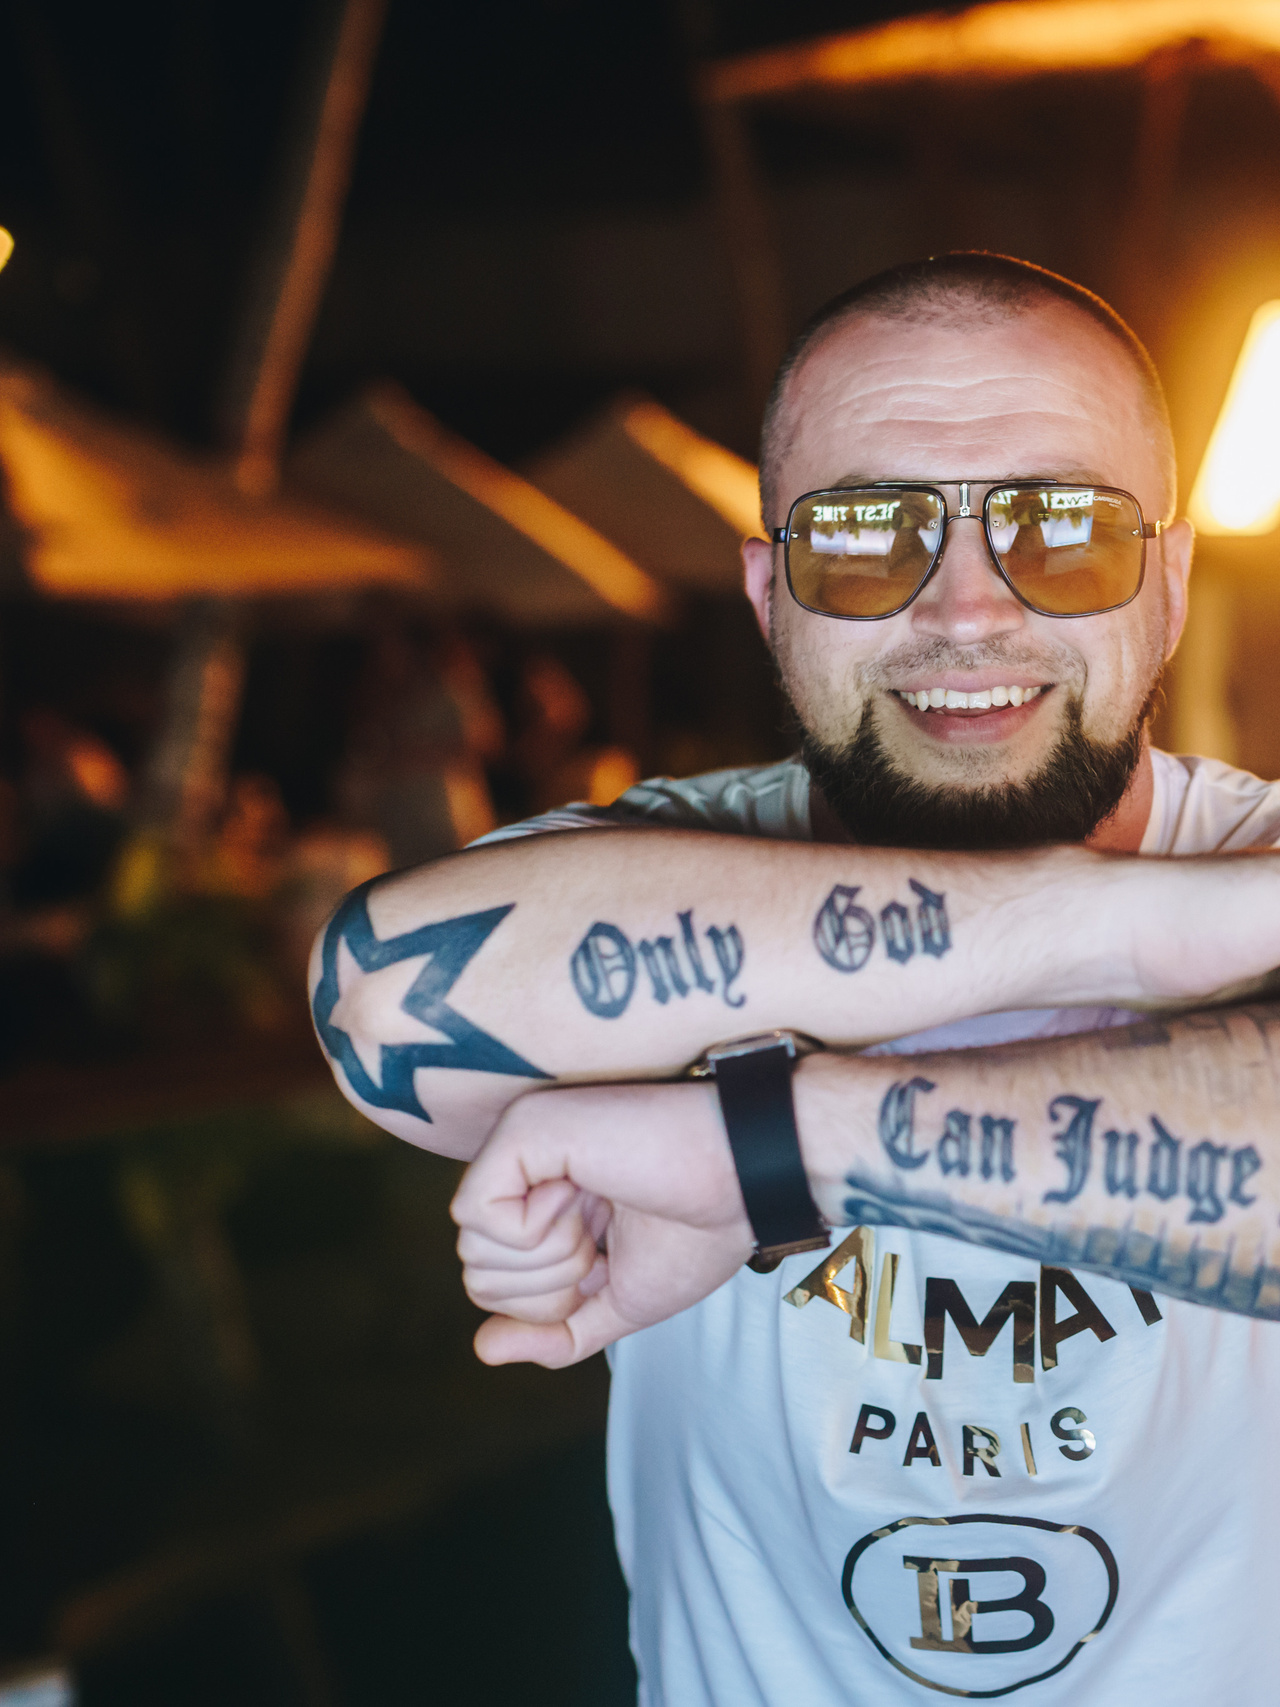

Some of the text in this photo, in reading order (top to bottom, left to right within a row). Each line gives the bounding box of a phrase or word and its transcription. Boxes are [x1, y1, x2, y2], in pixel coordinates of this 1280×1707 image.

[569, 877, 954, 1019] Only God
[878, 1076, 1019, 1185] Can
[1044, 1094, 1263, 1225] Judge
[783, 1225, 1163, 1384] ALMA
[849, 1403, 1096, 1478] PARIS
